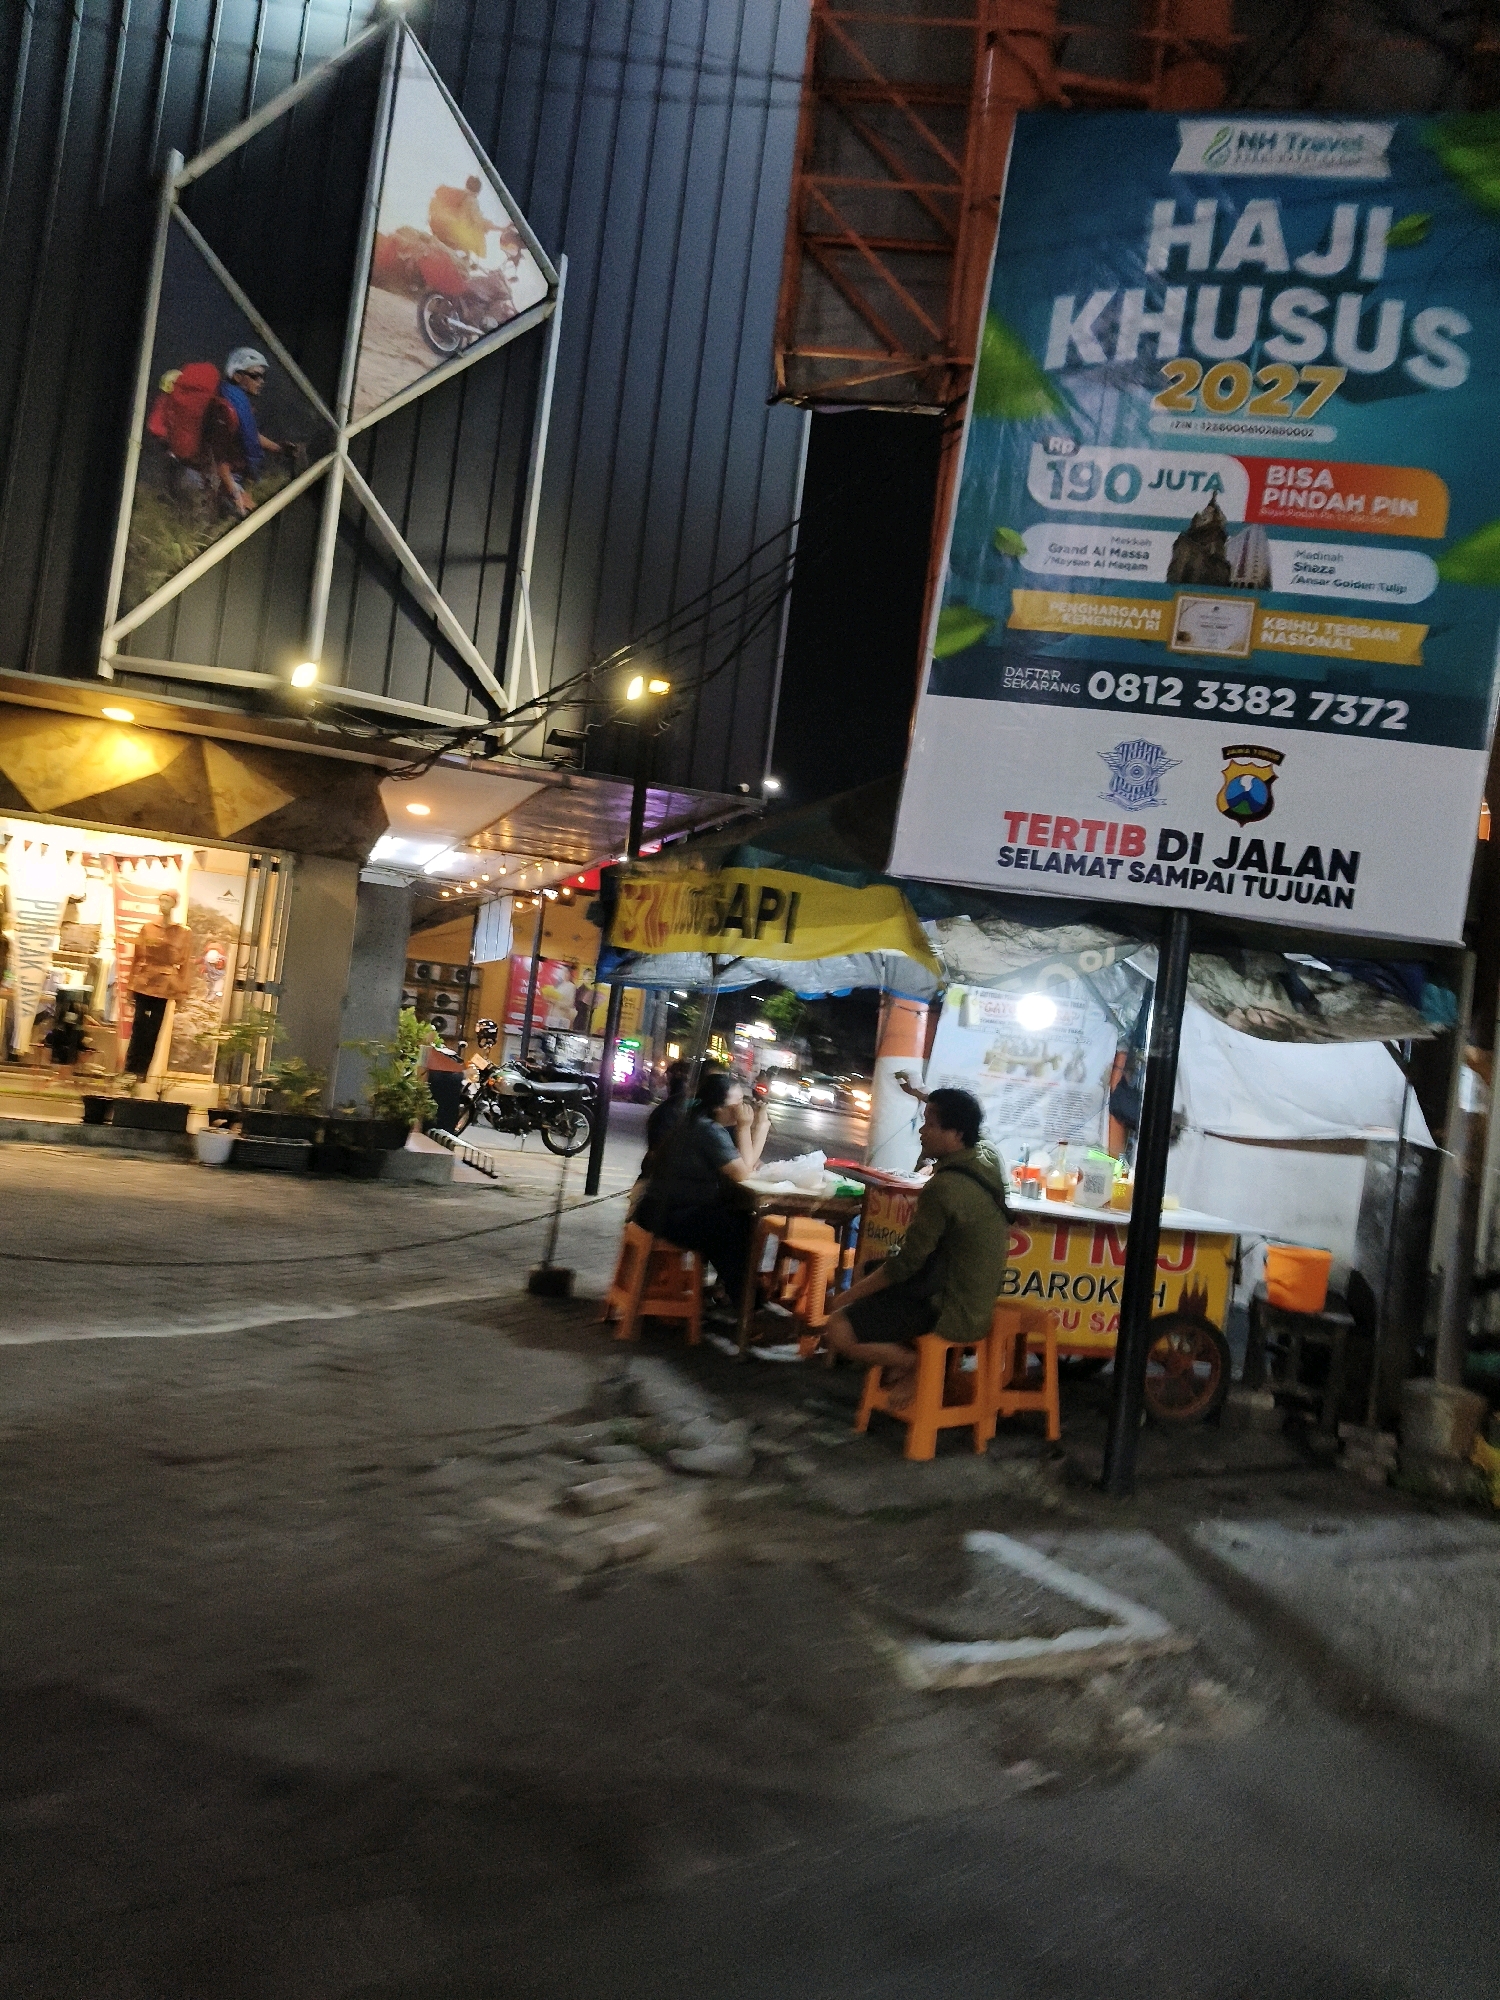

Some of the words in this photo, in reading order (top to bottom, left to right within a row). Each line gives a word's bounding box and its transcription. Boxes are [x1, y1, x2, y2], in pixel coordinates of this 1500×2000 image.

[1237, 131, 1279, 151] NH
[1145, 198, 1394, 281] HAJI
[1044, 285, 1474, 390] KHUSUS
[1150, 358, 1348, 420] 2027
[1048, 436, 1076, 456] Rp
[1047, 459, 1143, 505] 190
[1148, 468, 1225, 494] JUTA
[1265, 465, 1335, 490] BISA
[1261, 487, 1367, 513] PINDAH
[1370, 496, 1420, 518] PIN
[1048, 542, 1088, 555] Grand
[1110, 548, 1150, 560] Massa
[1295, 550, 1344, 563] Madinah
[1293, 561, 1336, 575] Shaza
[1049, 601, 1162, 620] PENGHARGAAN
[1061, 613, 1144, 630] KEMENHAJ
[1146, 619, 1160, 631] RI
[1260, 630, 1354, 651] NASIONAL
[1004, 666, 1061, 682] DAFTAR
[1002, 678, 1081, 694] SEKARANG
[1088, 670, 1183, 707] 0812
[1193, 680, 1297, 719] 3382
[1309, 691, 1410, 730] 7372
[1003, 811, 1146, 858] TERTIB
[1157, 828, 1204, 865] DI
[1212, 835, 1361, 885] JALAN
[997, 845, 1124, 882] SELAMAT
[1126, 861, 1235, 895] SAMPAI
[1243, 876, 1356, 910] TUJUAN
[1000, 1267, 1167, 1310] BAROKH
